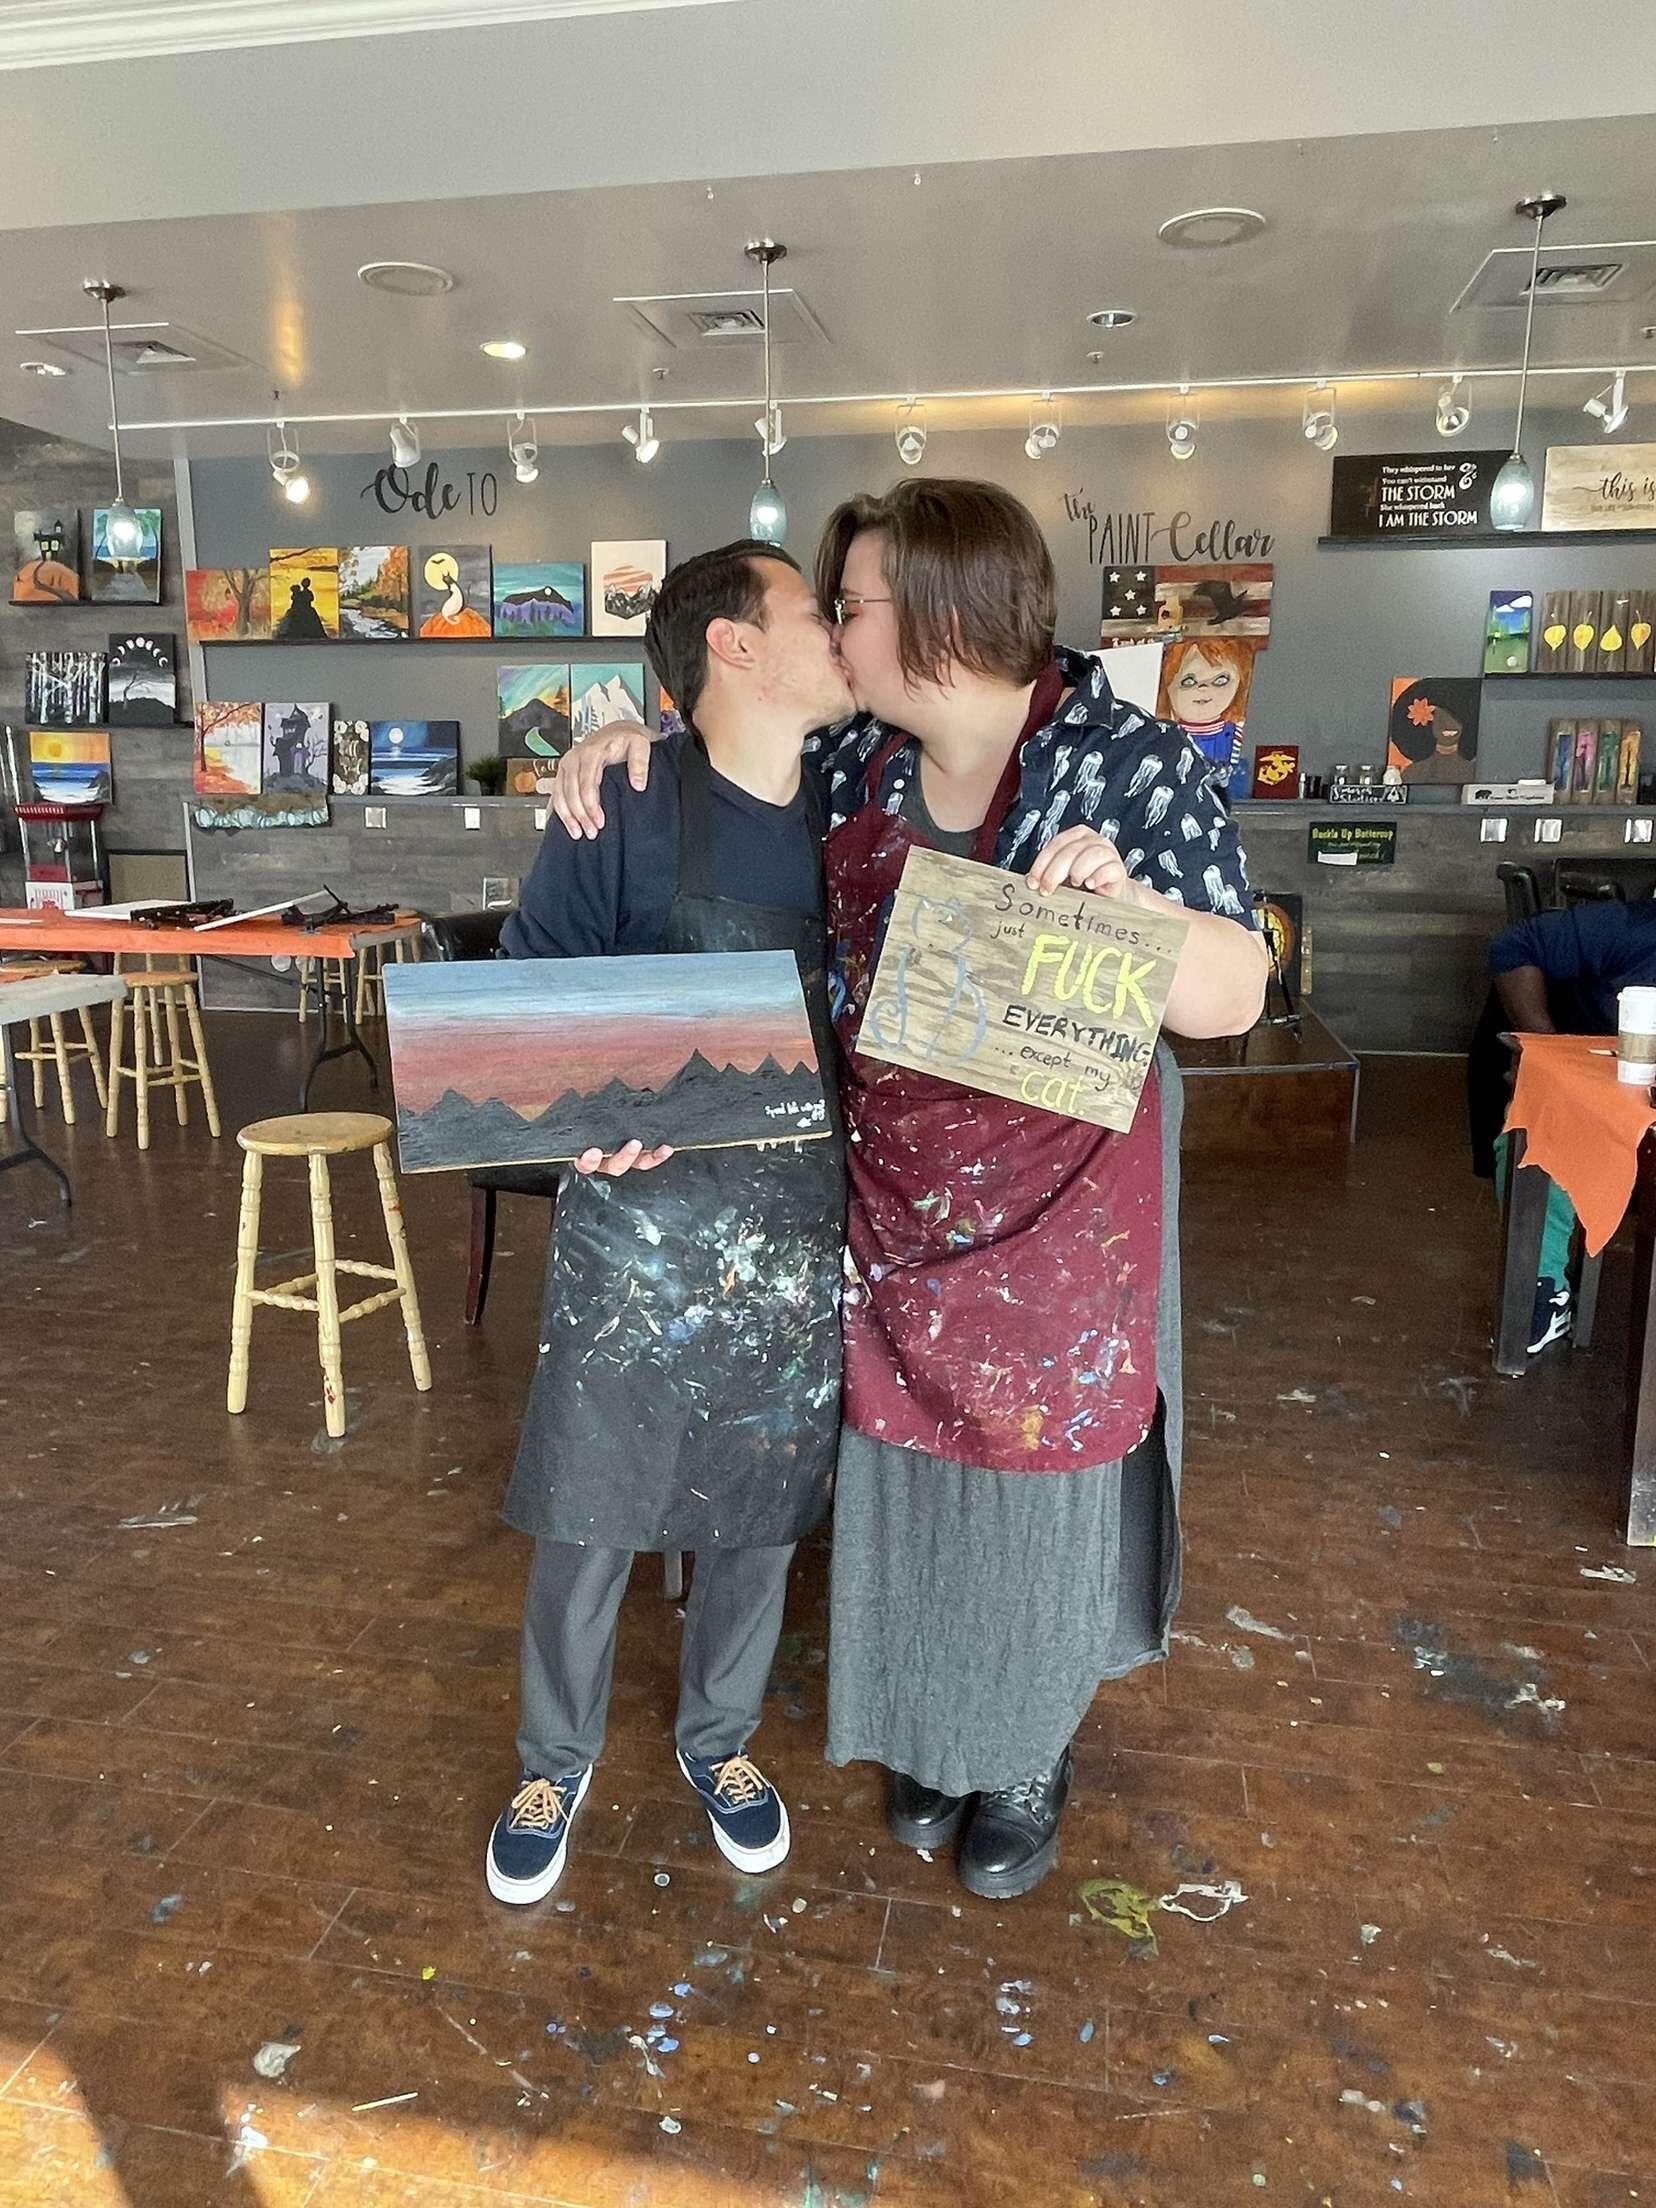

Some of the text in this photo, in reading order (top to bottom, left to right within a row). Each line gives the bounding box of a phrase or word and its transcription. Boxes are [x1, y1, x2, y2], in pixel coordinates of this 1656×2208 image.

[360, 462, 497, 520] Ode TO
[1381, 485, 1455, 502] THE STORM
[1572, 472, 1655, 502] this is
[1379, 510, 1478, 528] I AM THE STORM
[1089, 511, 1275, 565] PAINT Cellar
[990, 921, 1025, 939] just
[1021, 934, 1157, 1028] FUCK
[1085, 1065, 1111, 1092] my
